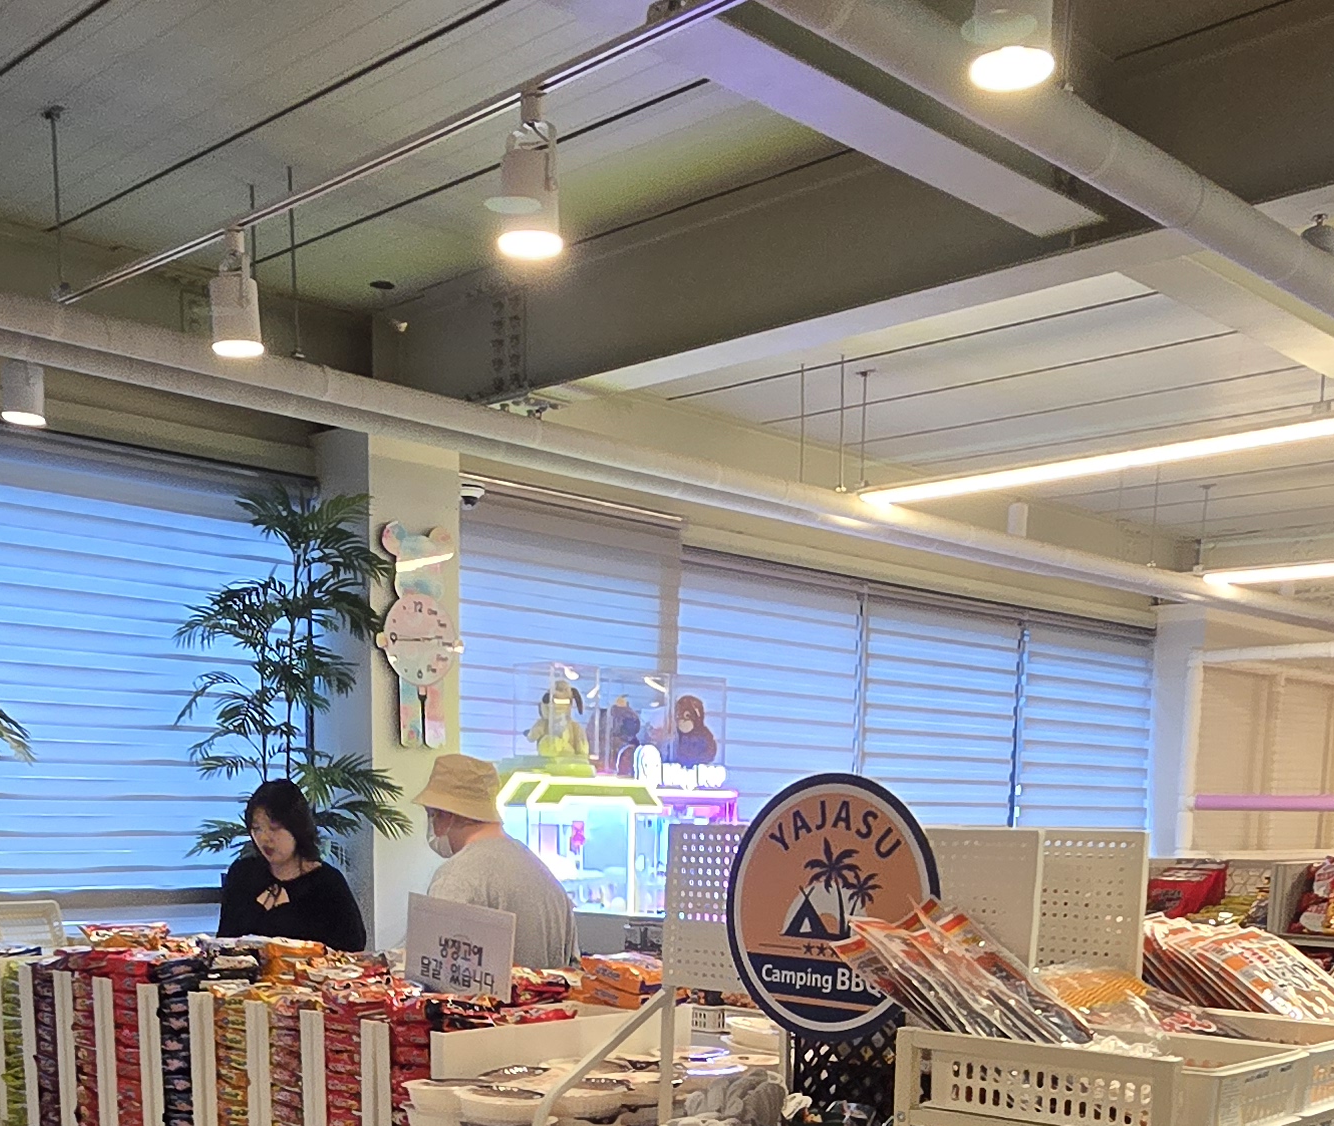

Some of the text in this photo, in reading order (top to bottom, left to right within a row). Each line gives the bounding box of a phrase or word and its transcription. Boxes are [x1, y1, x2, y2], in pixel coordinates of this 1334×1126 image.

[769, 800, 904, 859] YAJASU
[439, 935, 483, 967] 냉장고에
[762, 964, 833, 993] Camping
